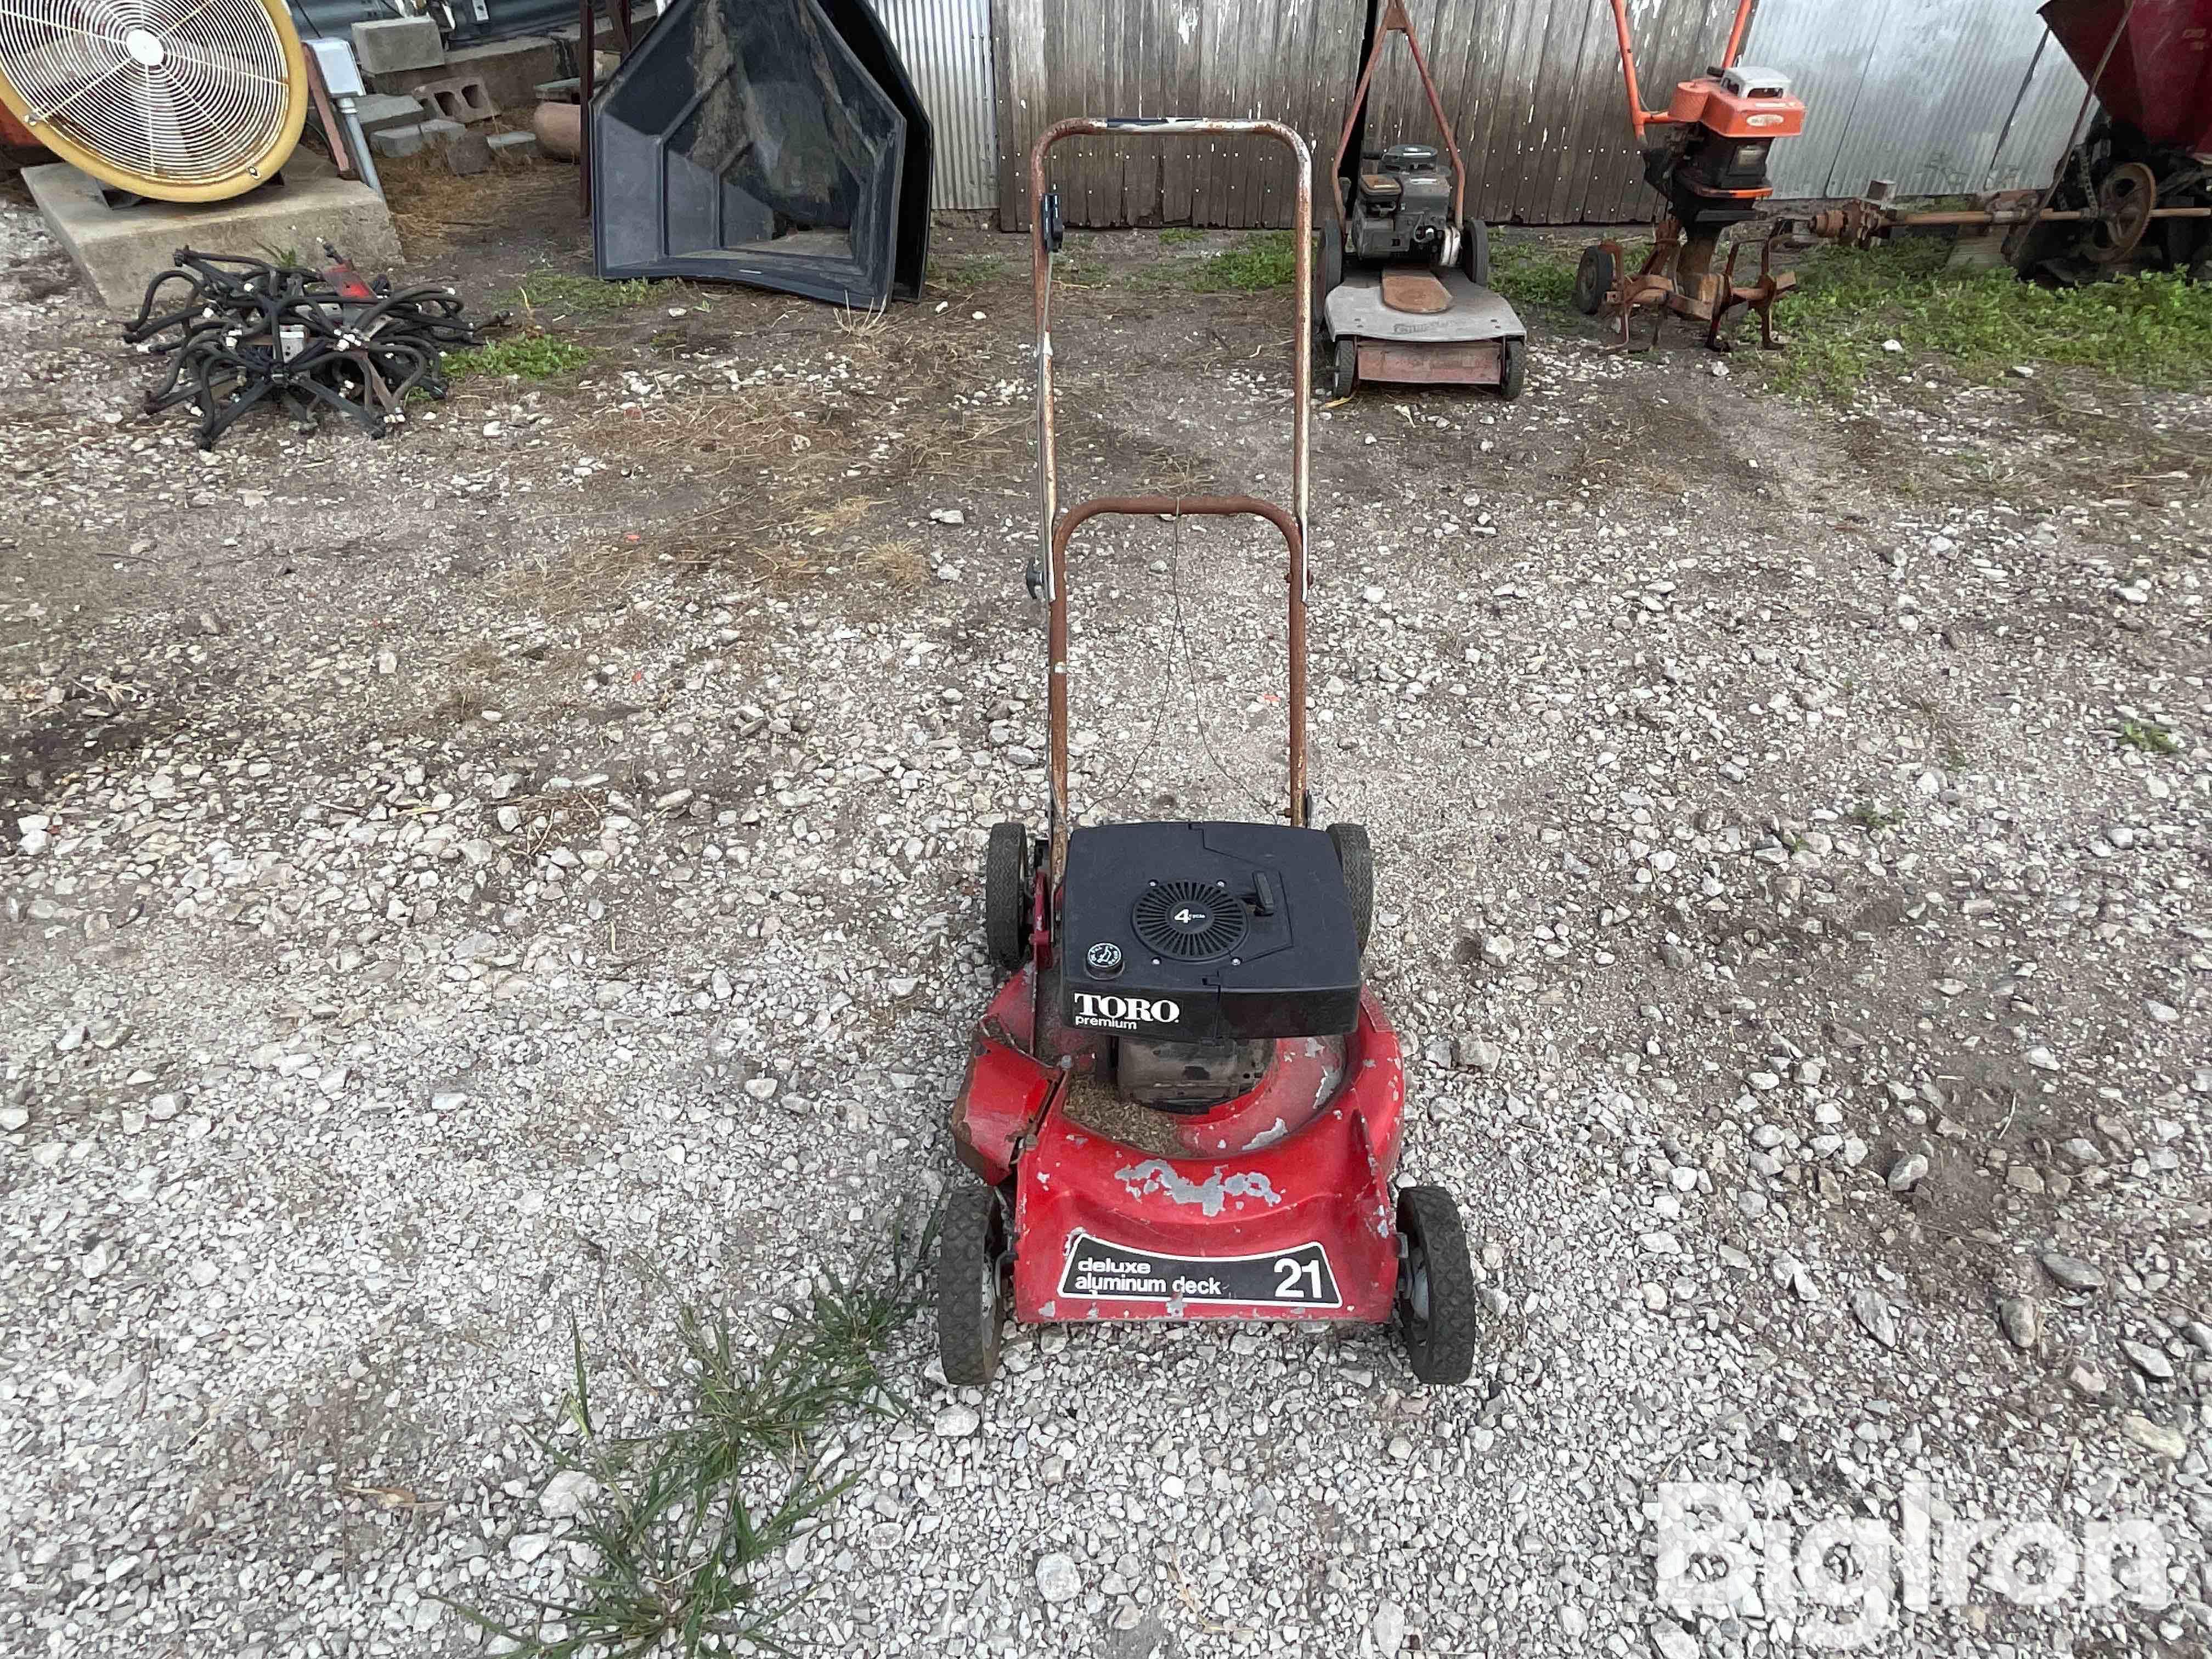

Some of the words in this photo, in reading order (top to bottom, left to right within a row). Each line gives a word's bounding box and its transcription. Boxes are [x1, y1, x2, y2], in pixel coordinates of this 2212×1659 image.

[1174, 909, 1191, 923] 4
[1074, 993, 1180, 1023] TORO
[1075, 1016, 1137, 1029] premium
[1078, 1257, 1151, 1274] deluxe
[1075, 1272, 1166, 1292] aluminum
[1172, 1276, 1221, 1295] deck
[1274, 1257, 1322, 1298] 21
